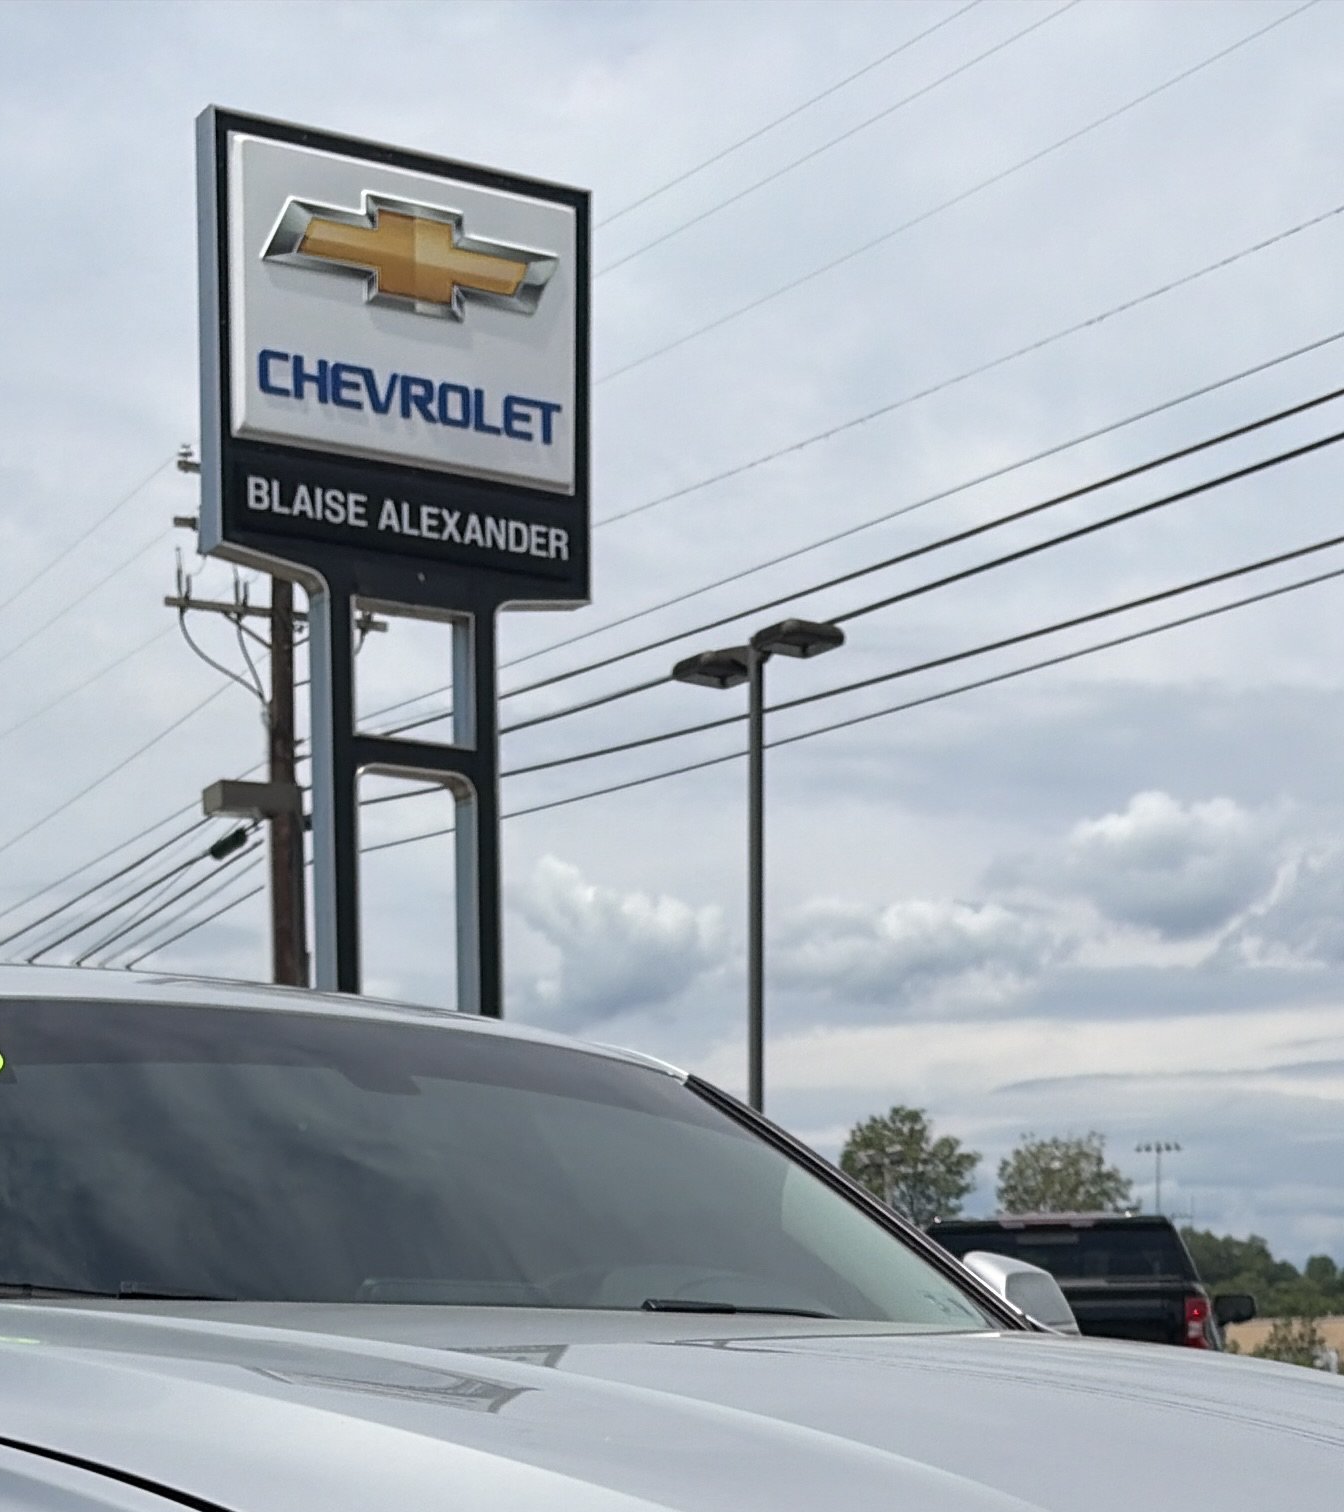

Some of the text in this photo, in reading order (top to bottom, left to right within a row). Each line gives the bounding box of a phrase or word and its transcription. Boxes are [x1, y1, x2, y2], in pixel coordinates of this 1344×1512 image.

[258, 349, 562, 445] CHEVROLET
[247, 475, 570, 561] BLAISE ALEXANDER
